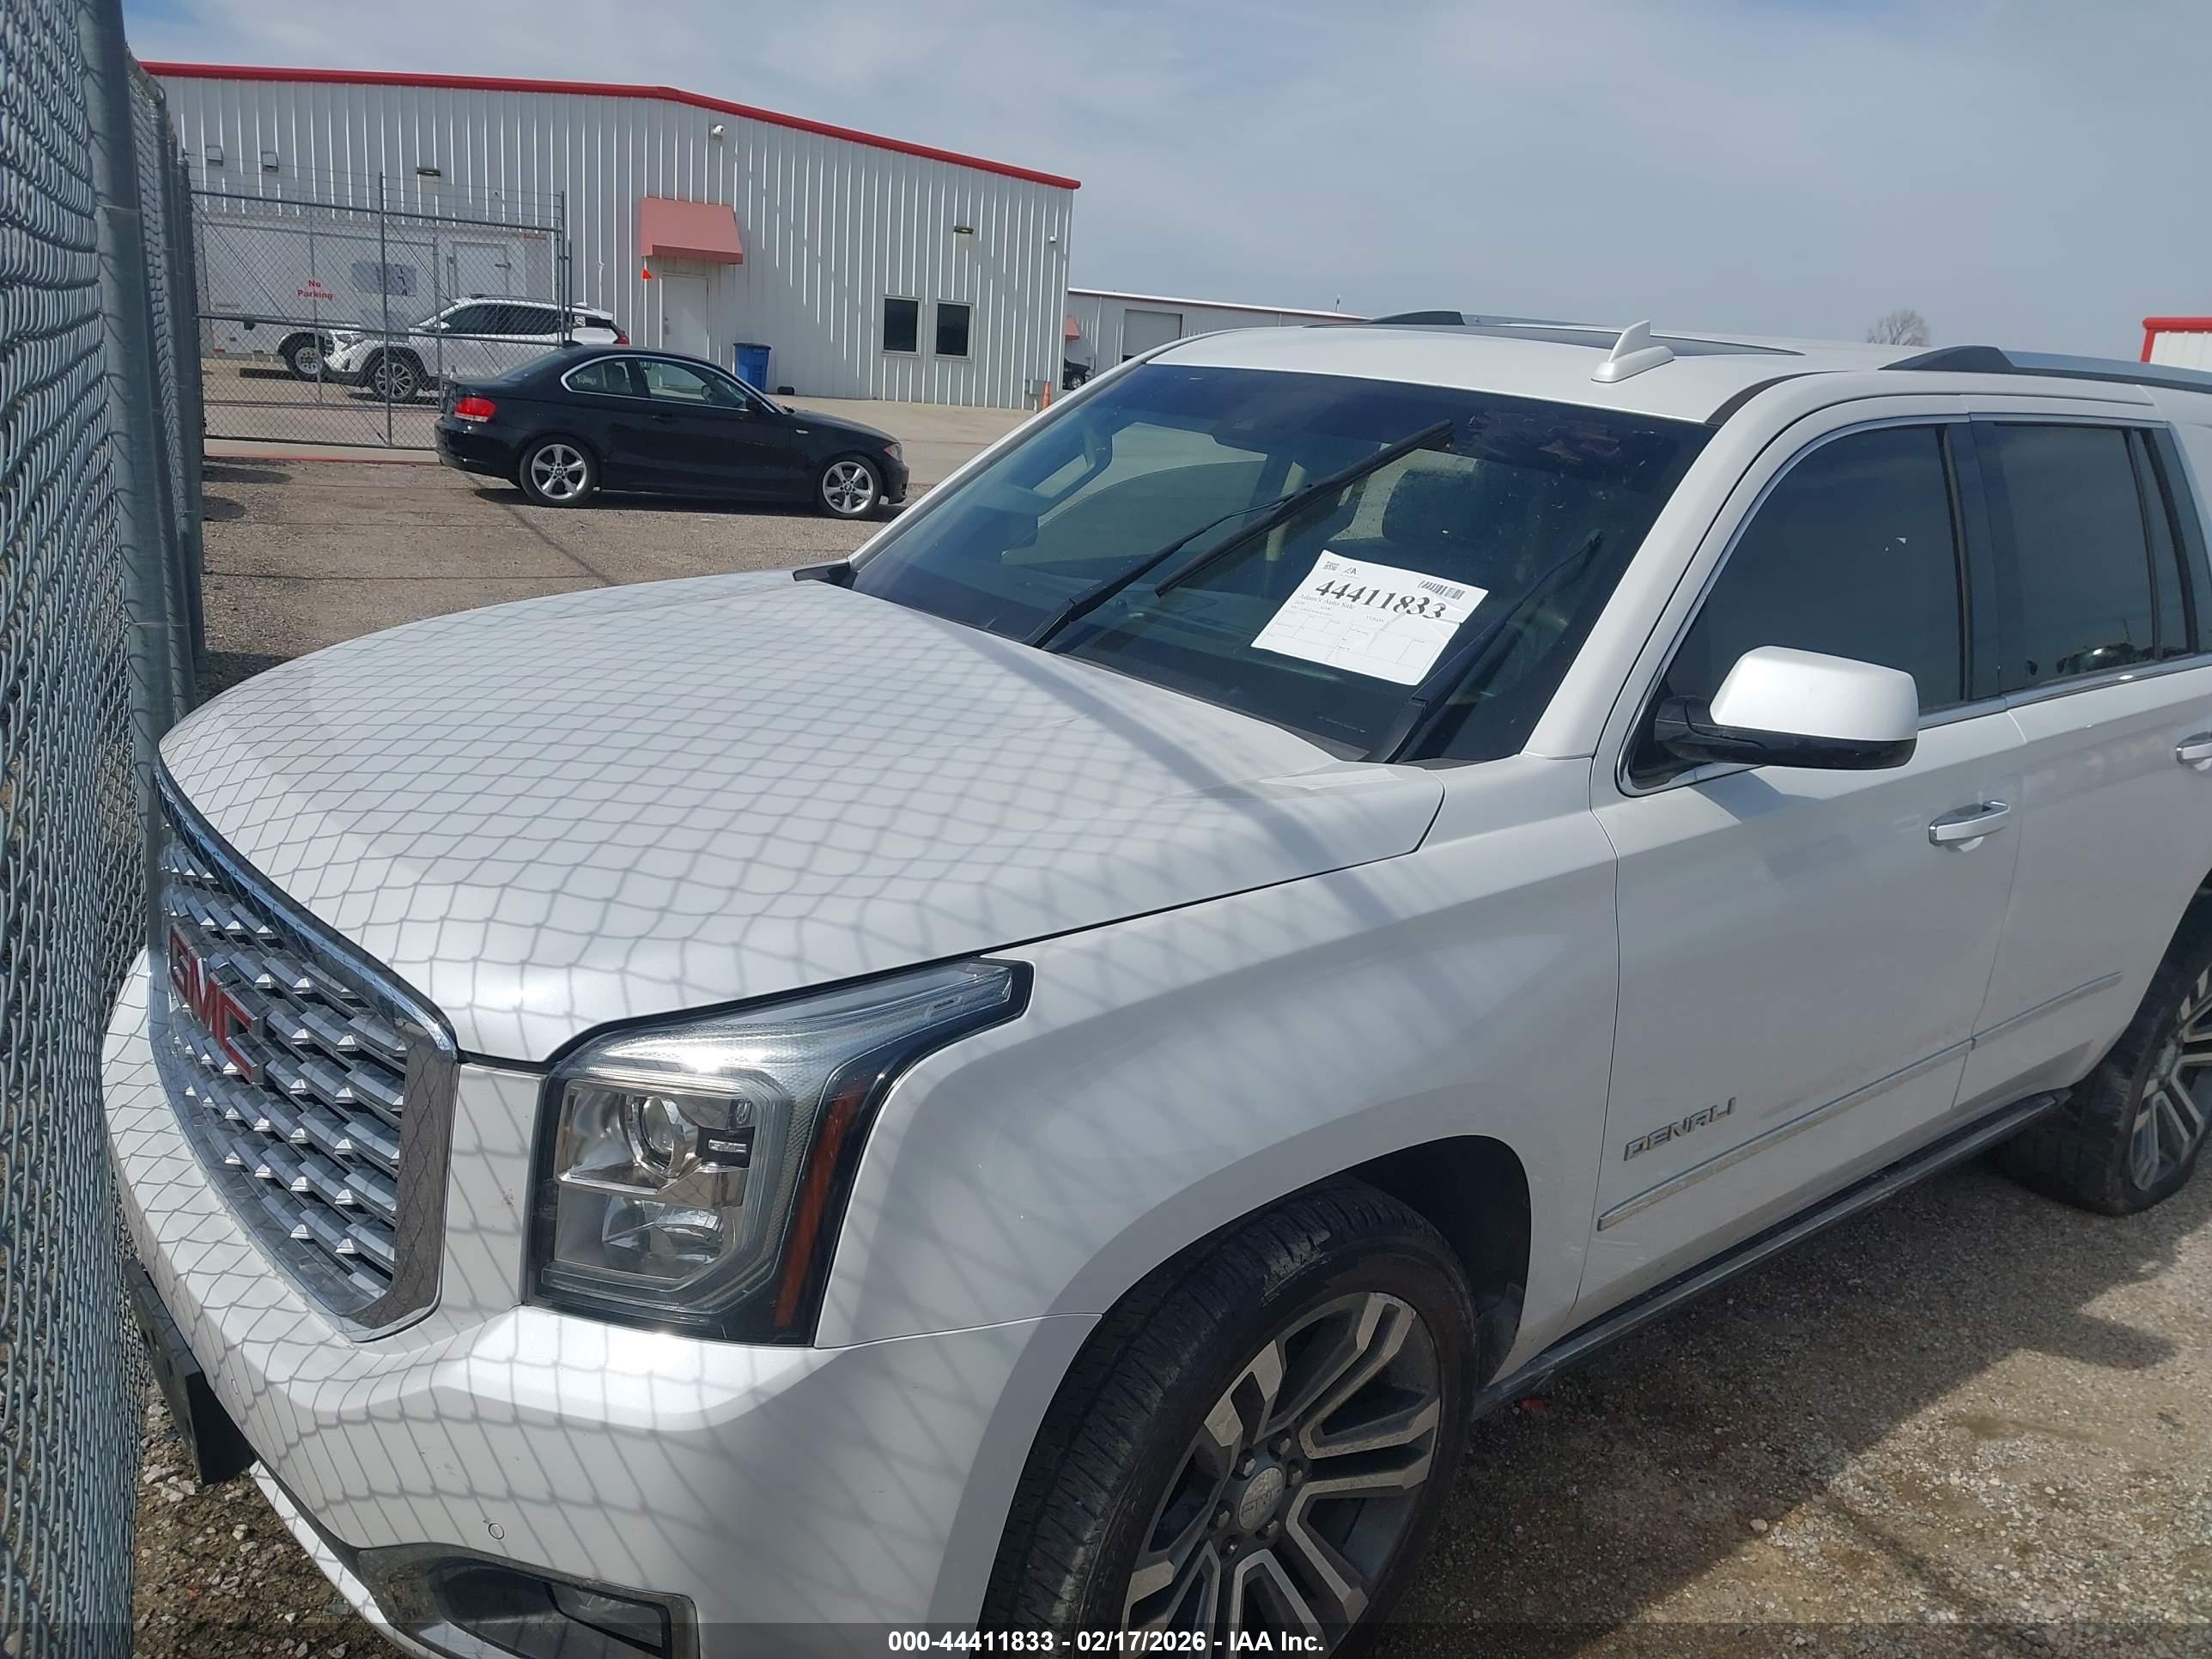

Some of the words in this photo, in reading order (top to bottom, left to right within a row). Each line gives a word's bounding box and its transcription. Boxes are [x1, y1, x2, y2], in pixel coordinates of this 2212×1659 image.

[297, 289, 333, 301] Parking
[308, 279, 321, 288] No
[1315, 580, 1448, 619] 44411833
[168, 924, 261, 1085] GMC
[1623, 1097, 1736, 1161] DENALI
